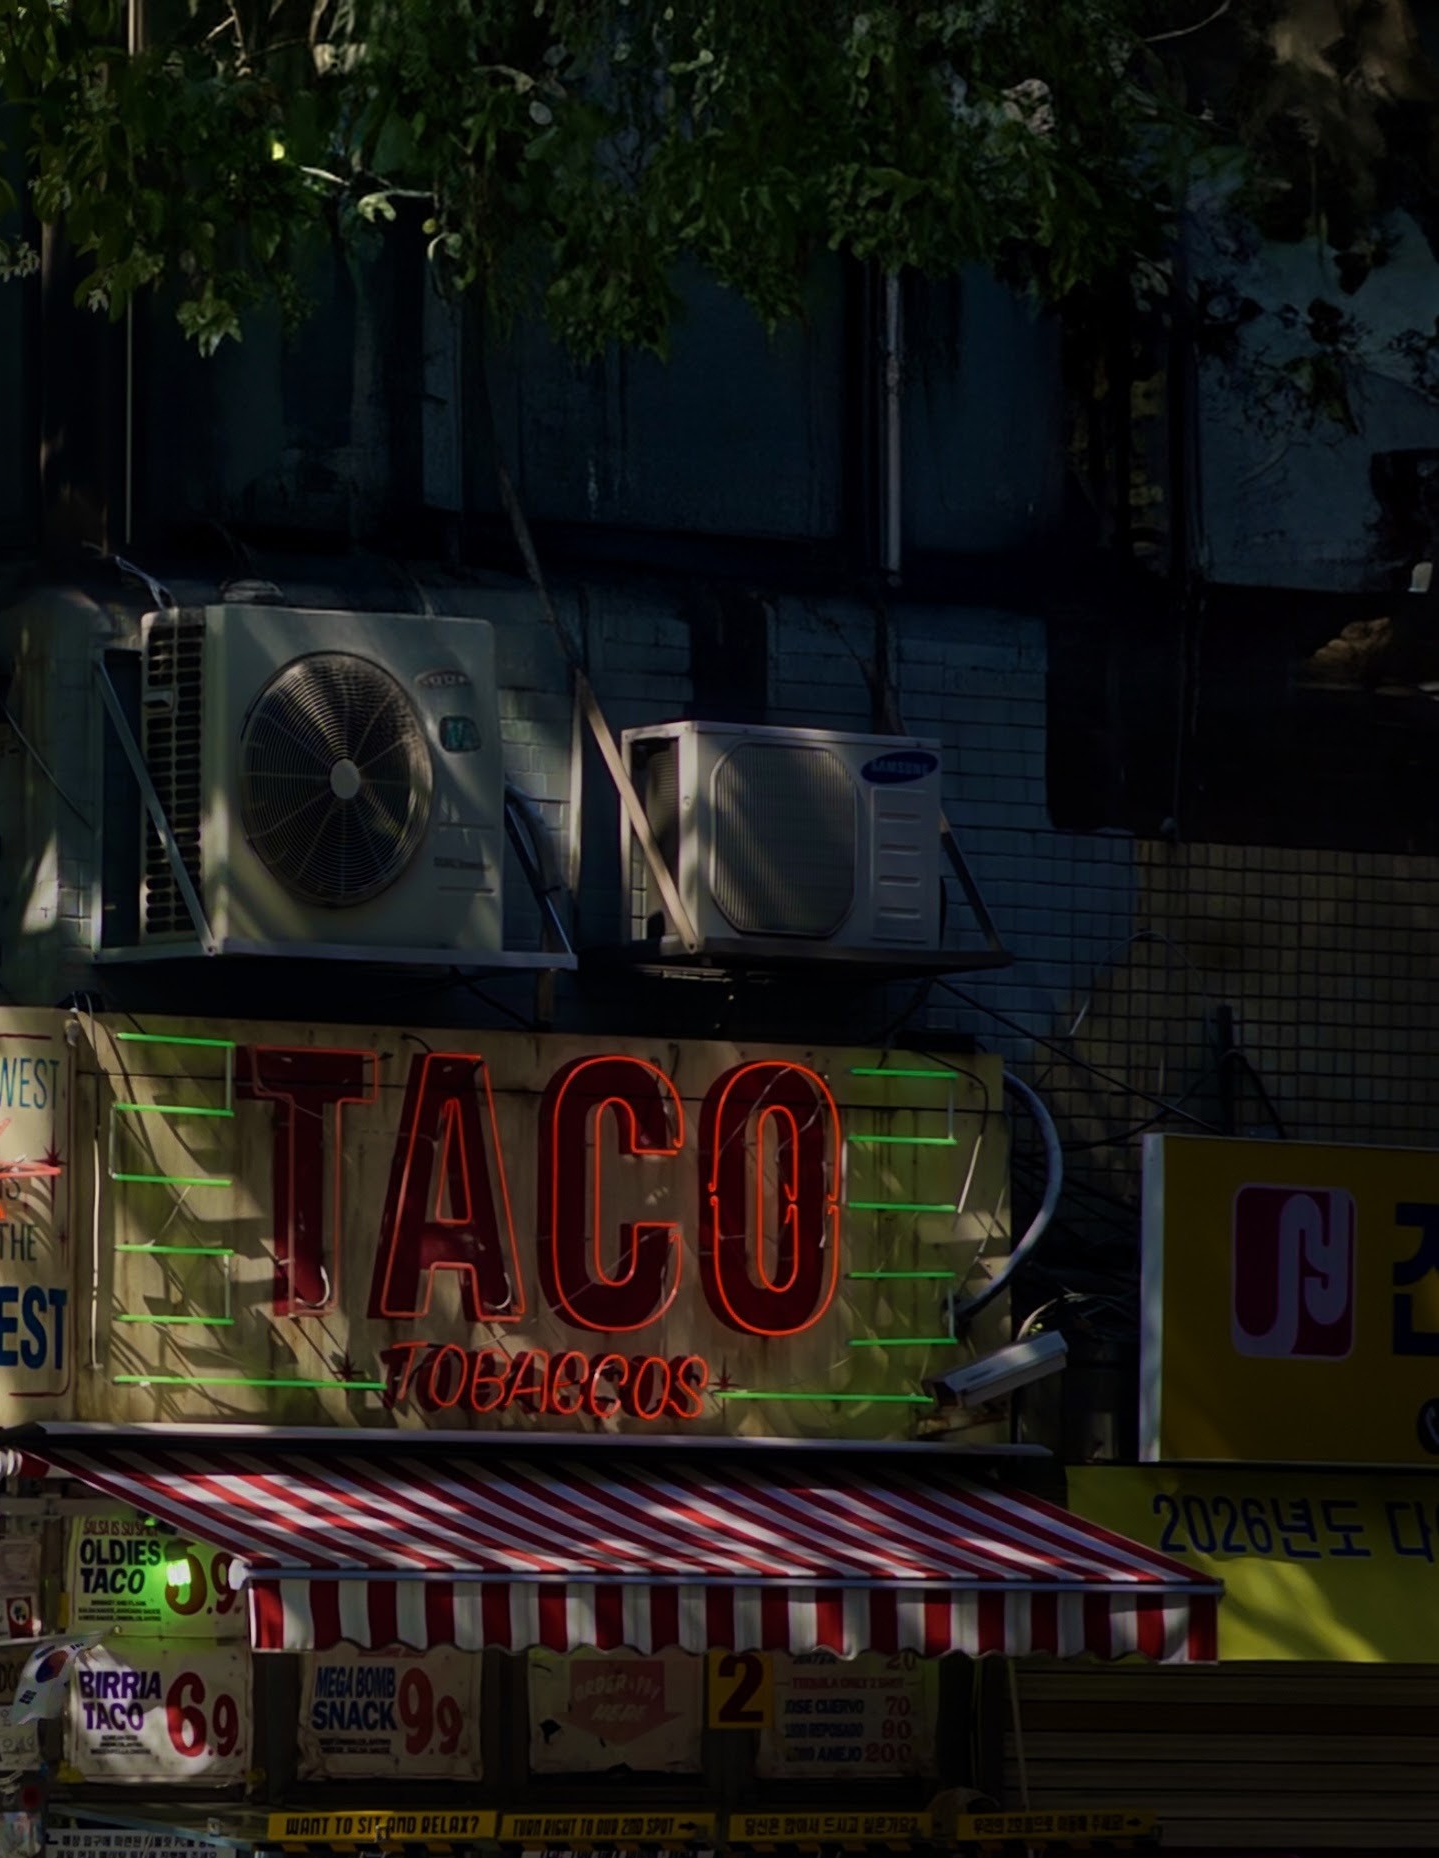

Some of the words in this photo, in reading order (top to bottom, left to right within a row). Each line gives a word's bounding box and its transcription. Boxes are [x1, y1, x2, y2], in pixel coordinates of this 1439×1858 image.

[870, 759, 930, 777] SAMSUNG
[235, 1043, 843, 1337] TACO
[380, 1341, 710, 1421] TOBACCOS
[1152, 1494, 1371, 1558] 2026년도
[1384, 1499, 1439, 1563] 다
[80, 1538, 161, 1566] OLDIES
[81, 1567, 146, 1594] TACO
[79, 1671, 161, 1699] BIRRIA
[316, 1667, 353, 1698] MEGA
[356, 1667, 396, 1698] BOMB
[718, 1654, 764, 1722] 2
[82, 1702, 144, 1731] TACO
[312, 1701, 398, 1731] SNACK
[885, 1695, 911, 1715] 70
[286, 1818, 329, 1836] WANT
[335, 1817, 353, 1835] TO
[357, 1816, 381, 1834] SIT
[386, 1816, 416, 1834] AND
[422, 1815, 479, 1834] RELAX?
[513, 1819, 542, 1837] TURN
[544, 1819, 576, 1836] RIGHT
[580, 1819, 593, 1836] TO
[646, 1818, 674, 1836] SPOT
